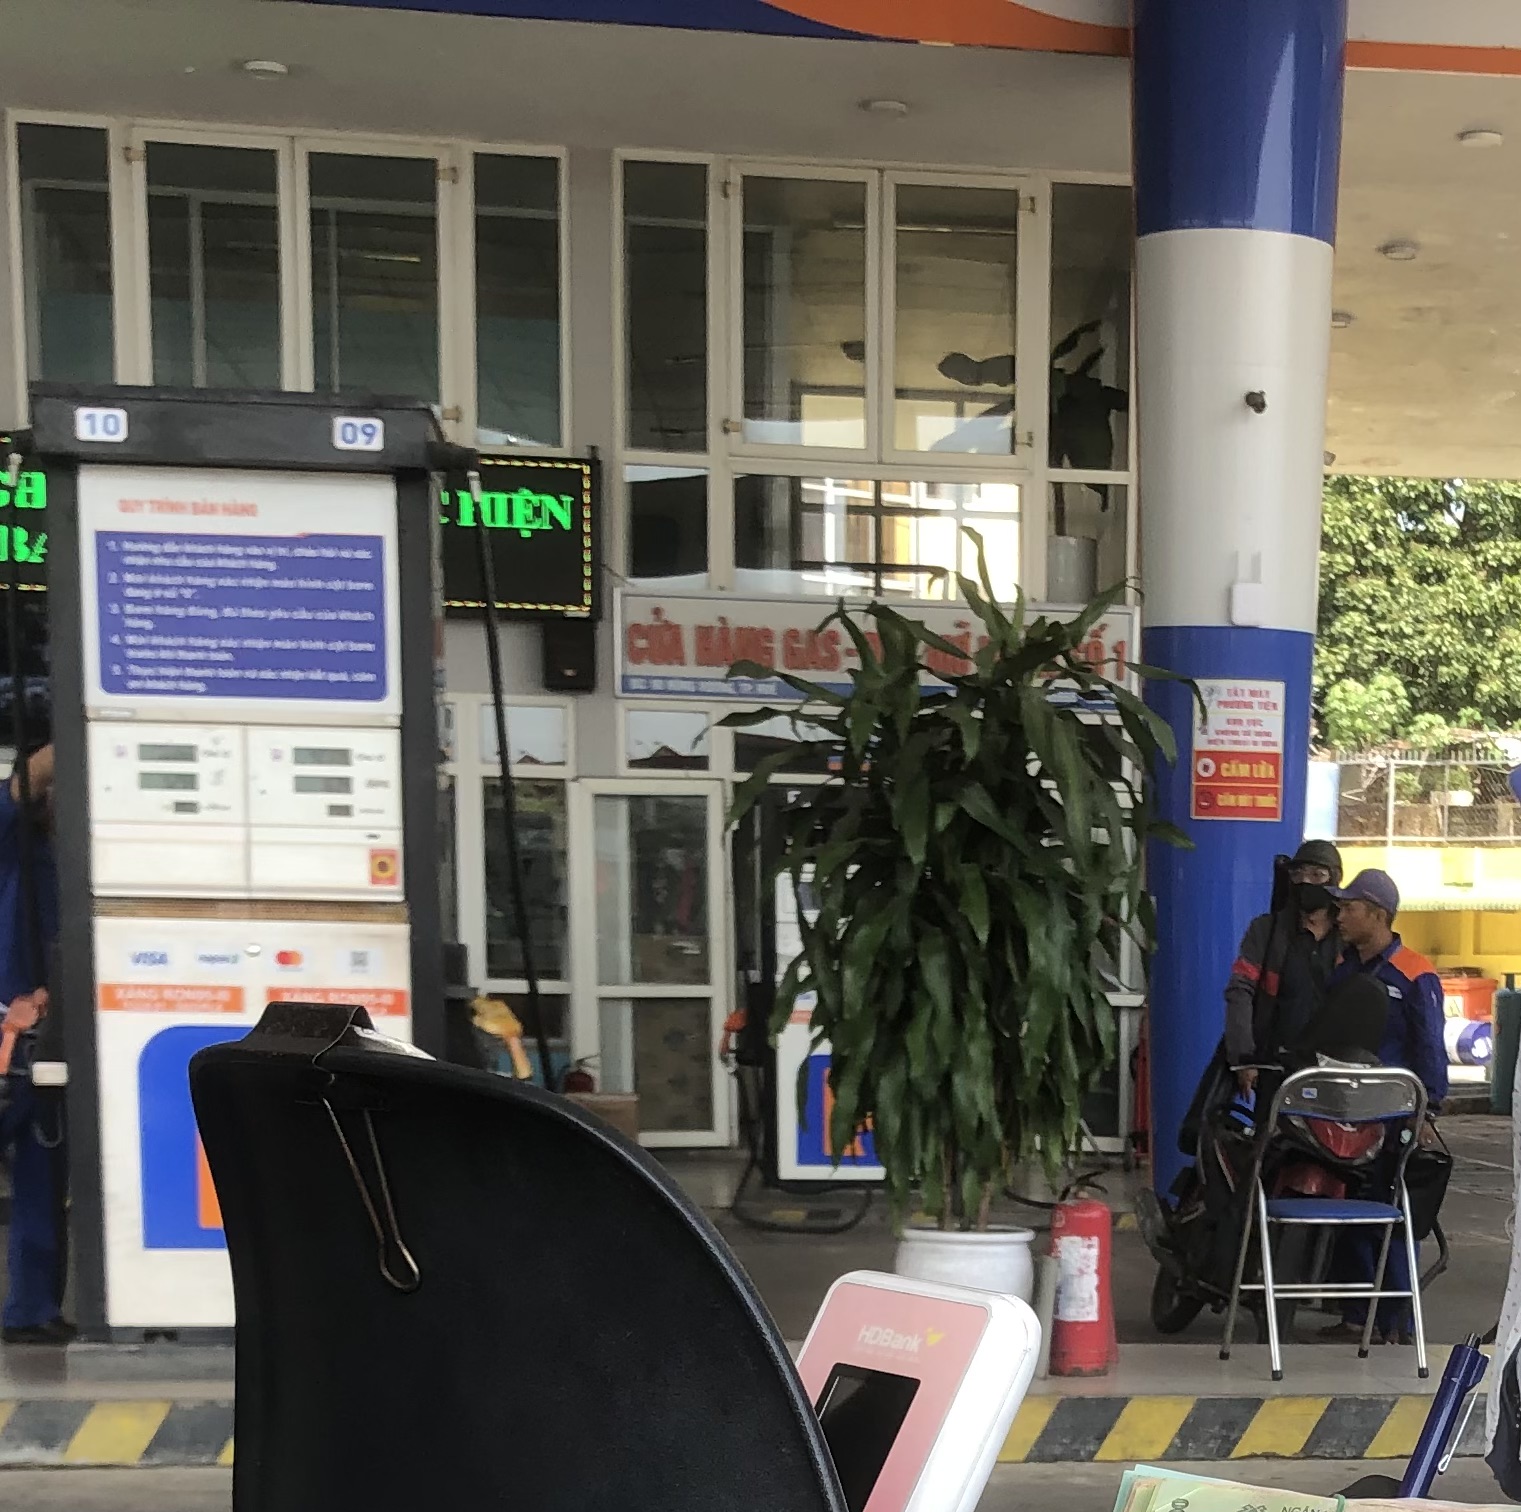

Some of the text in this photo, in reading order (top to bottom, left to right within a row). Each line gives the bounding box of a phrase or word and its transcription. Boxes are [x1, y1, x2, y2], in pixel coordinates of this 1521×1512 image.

[83, 414, 121, 437] 10
[341, 422, 377, 445] 09
[783, 628, 841, 670] GAS
[857, 1325, 922, 1353] HDBank
